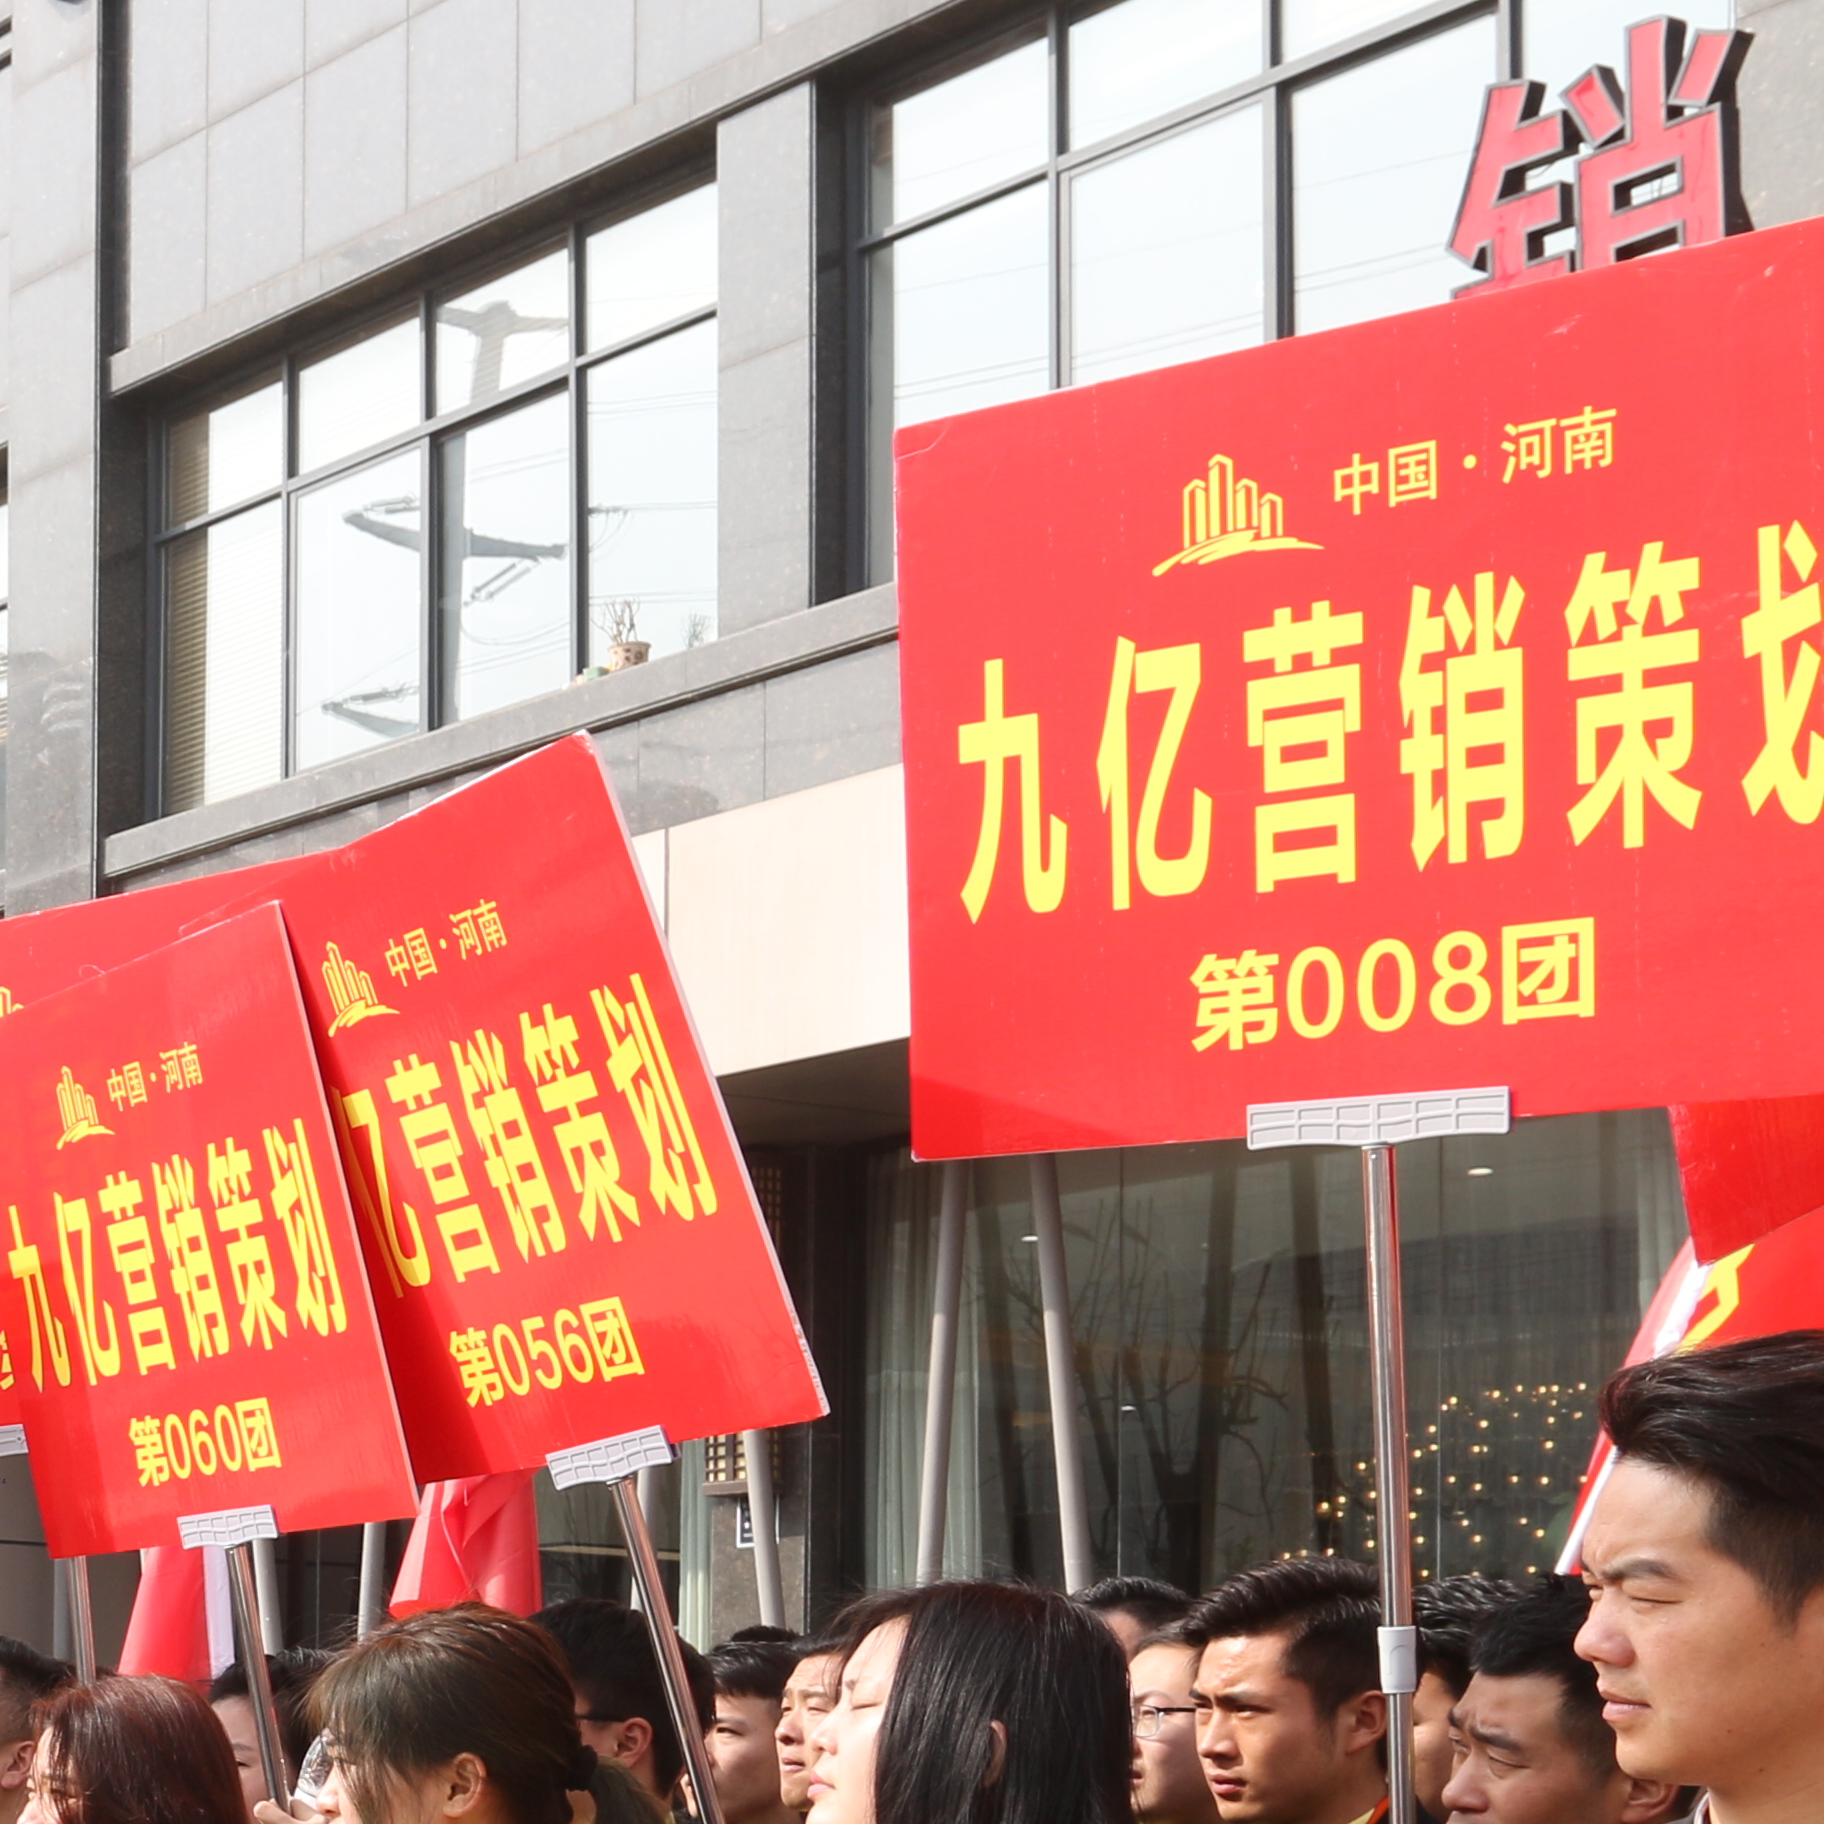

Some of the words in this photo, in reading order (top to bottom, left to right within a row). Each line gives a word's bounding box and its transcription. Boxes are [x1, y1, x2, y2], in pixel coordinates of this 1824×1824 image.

[1189, 917, 1596, 1052] 第008团
[7, 1117, 349, 1393] 九亿营销策划
[447, 1297, 645, 1408] 第056团
[129, 1396, 283, 1489] 第060团
